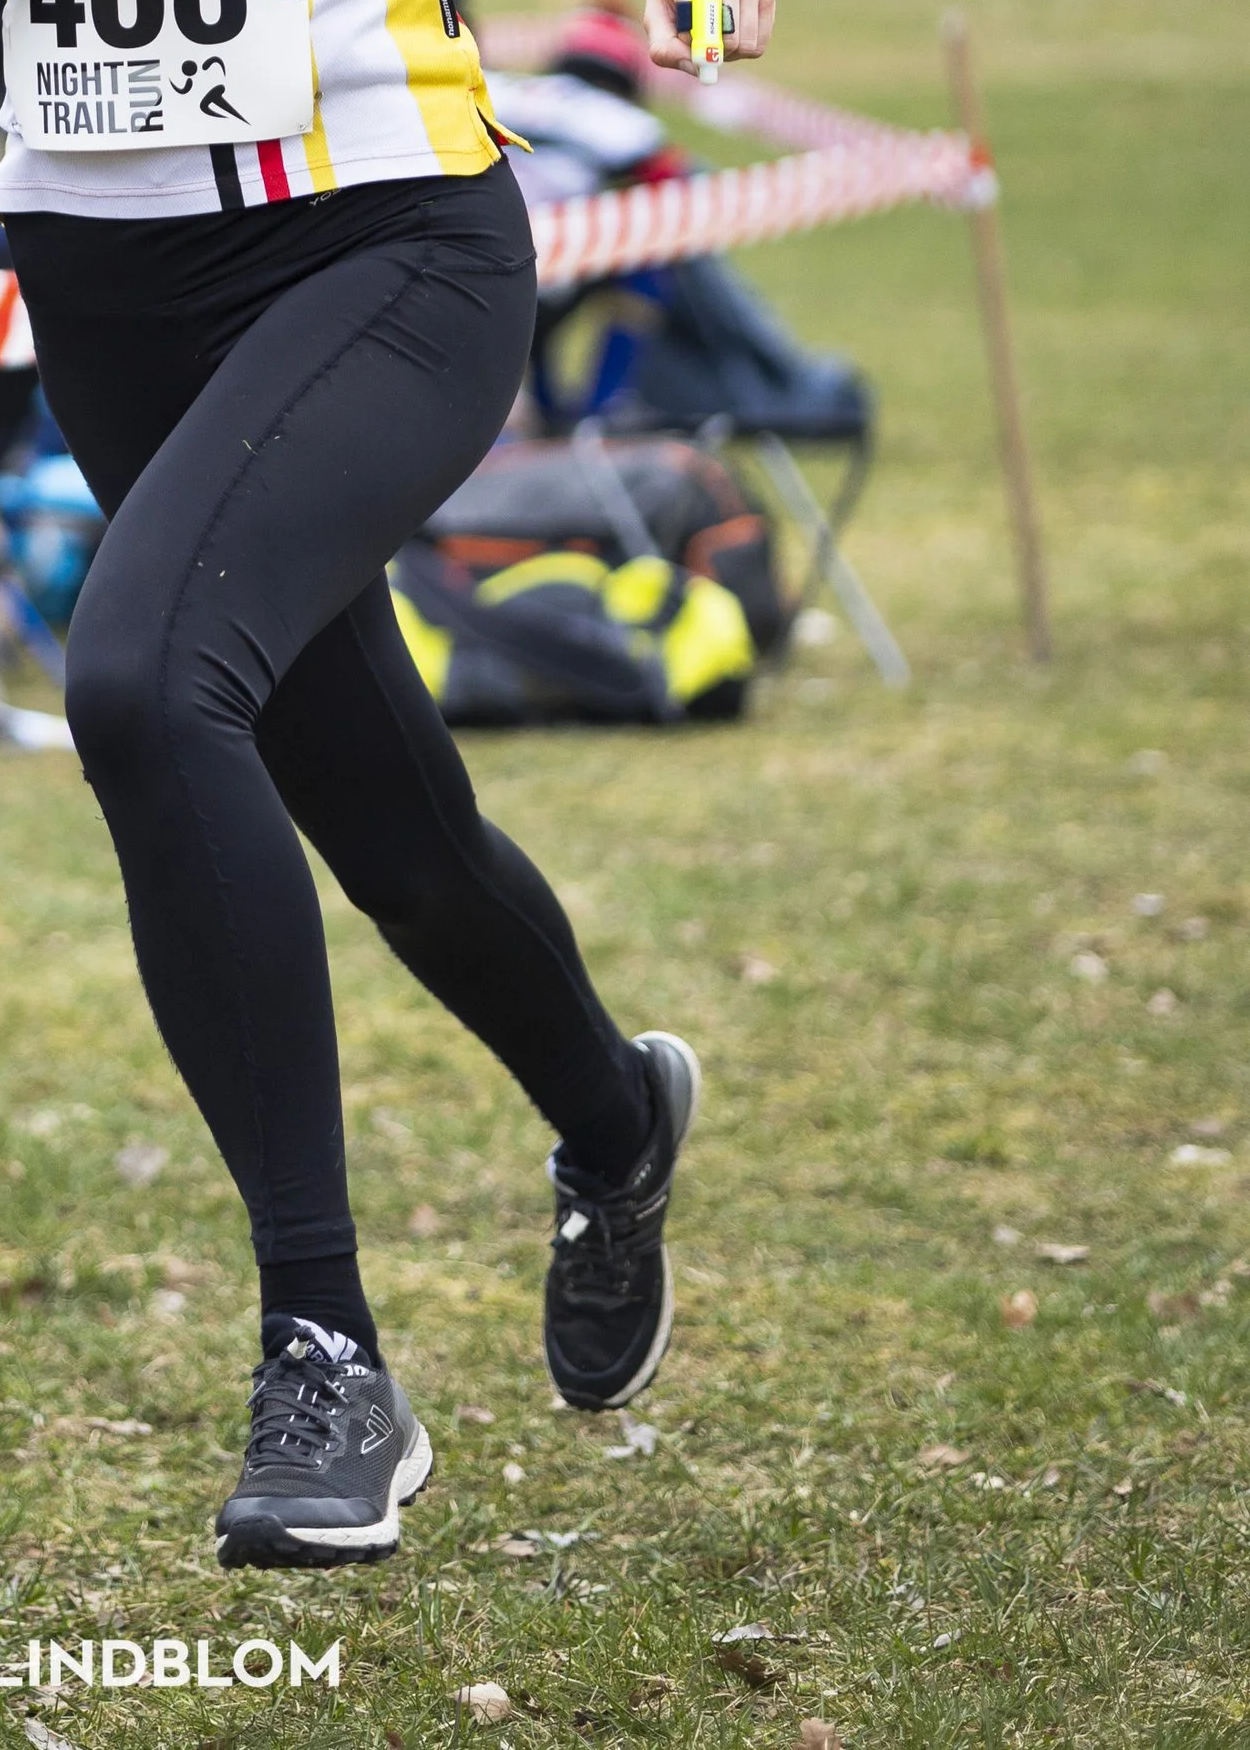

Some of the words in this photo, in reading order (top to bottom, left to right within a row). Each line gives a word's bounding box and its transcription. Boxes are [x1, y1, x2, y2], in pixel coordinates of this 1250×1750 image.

[36, 61, 124, 96] NIGHT
[127, 59, 164, 133] RUN
[38, 101, 128, 135] TRAIL
